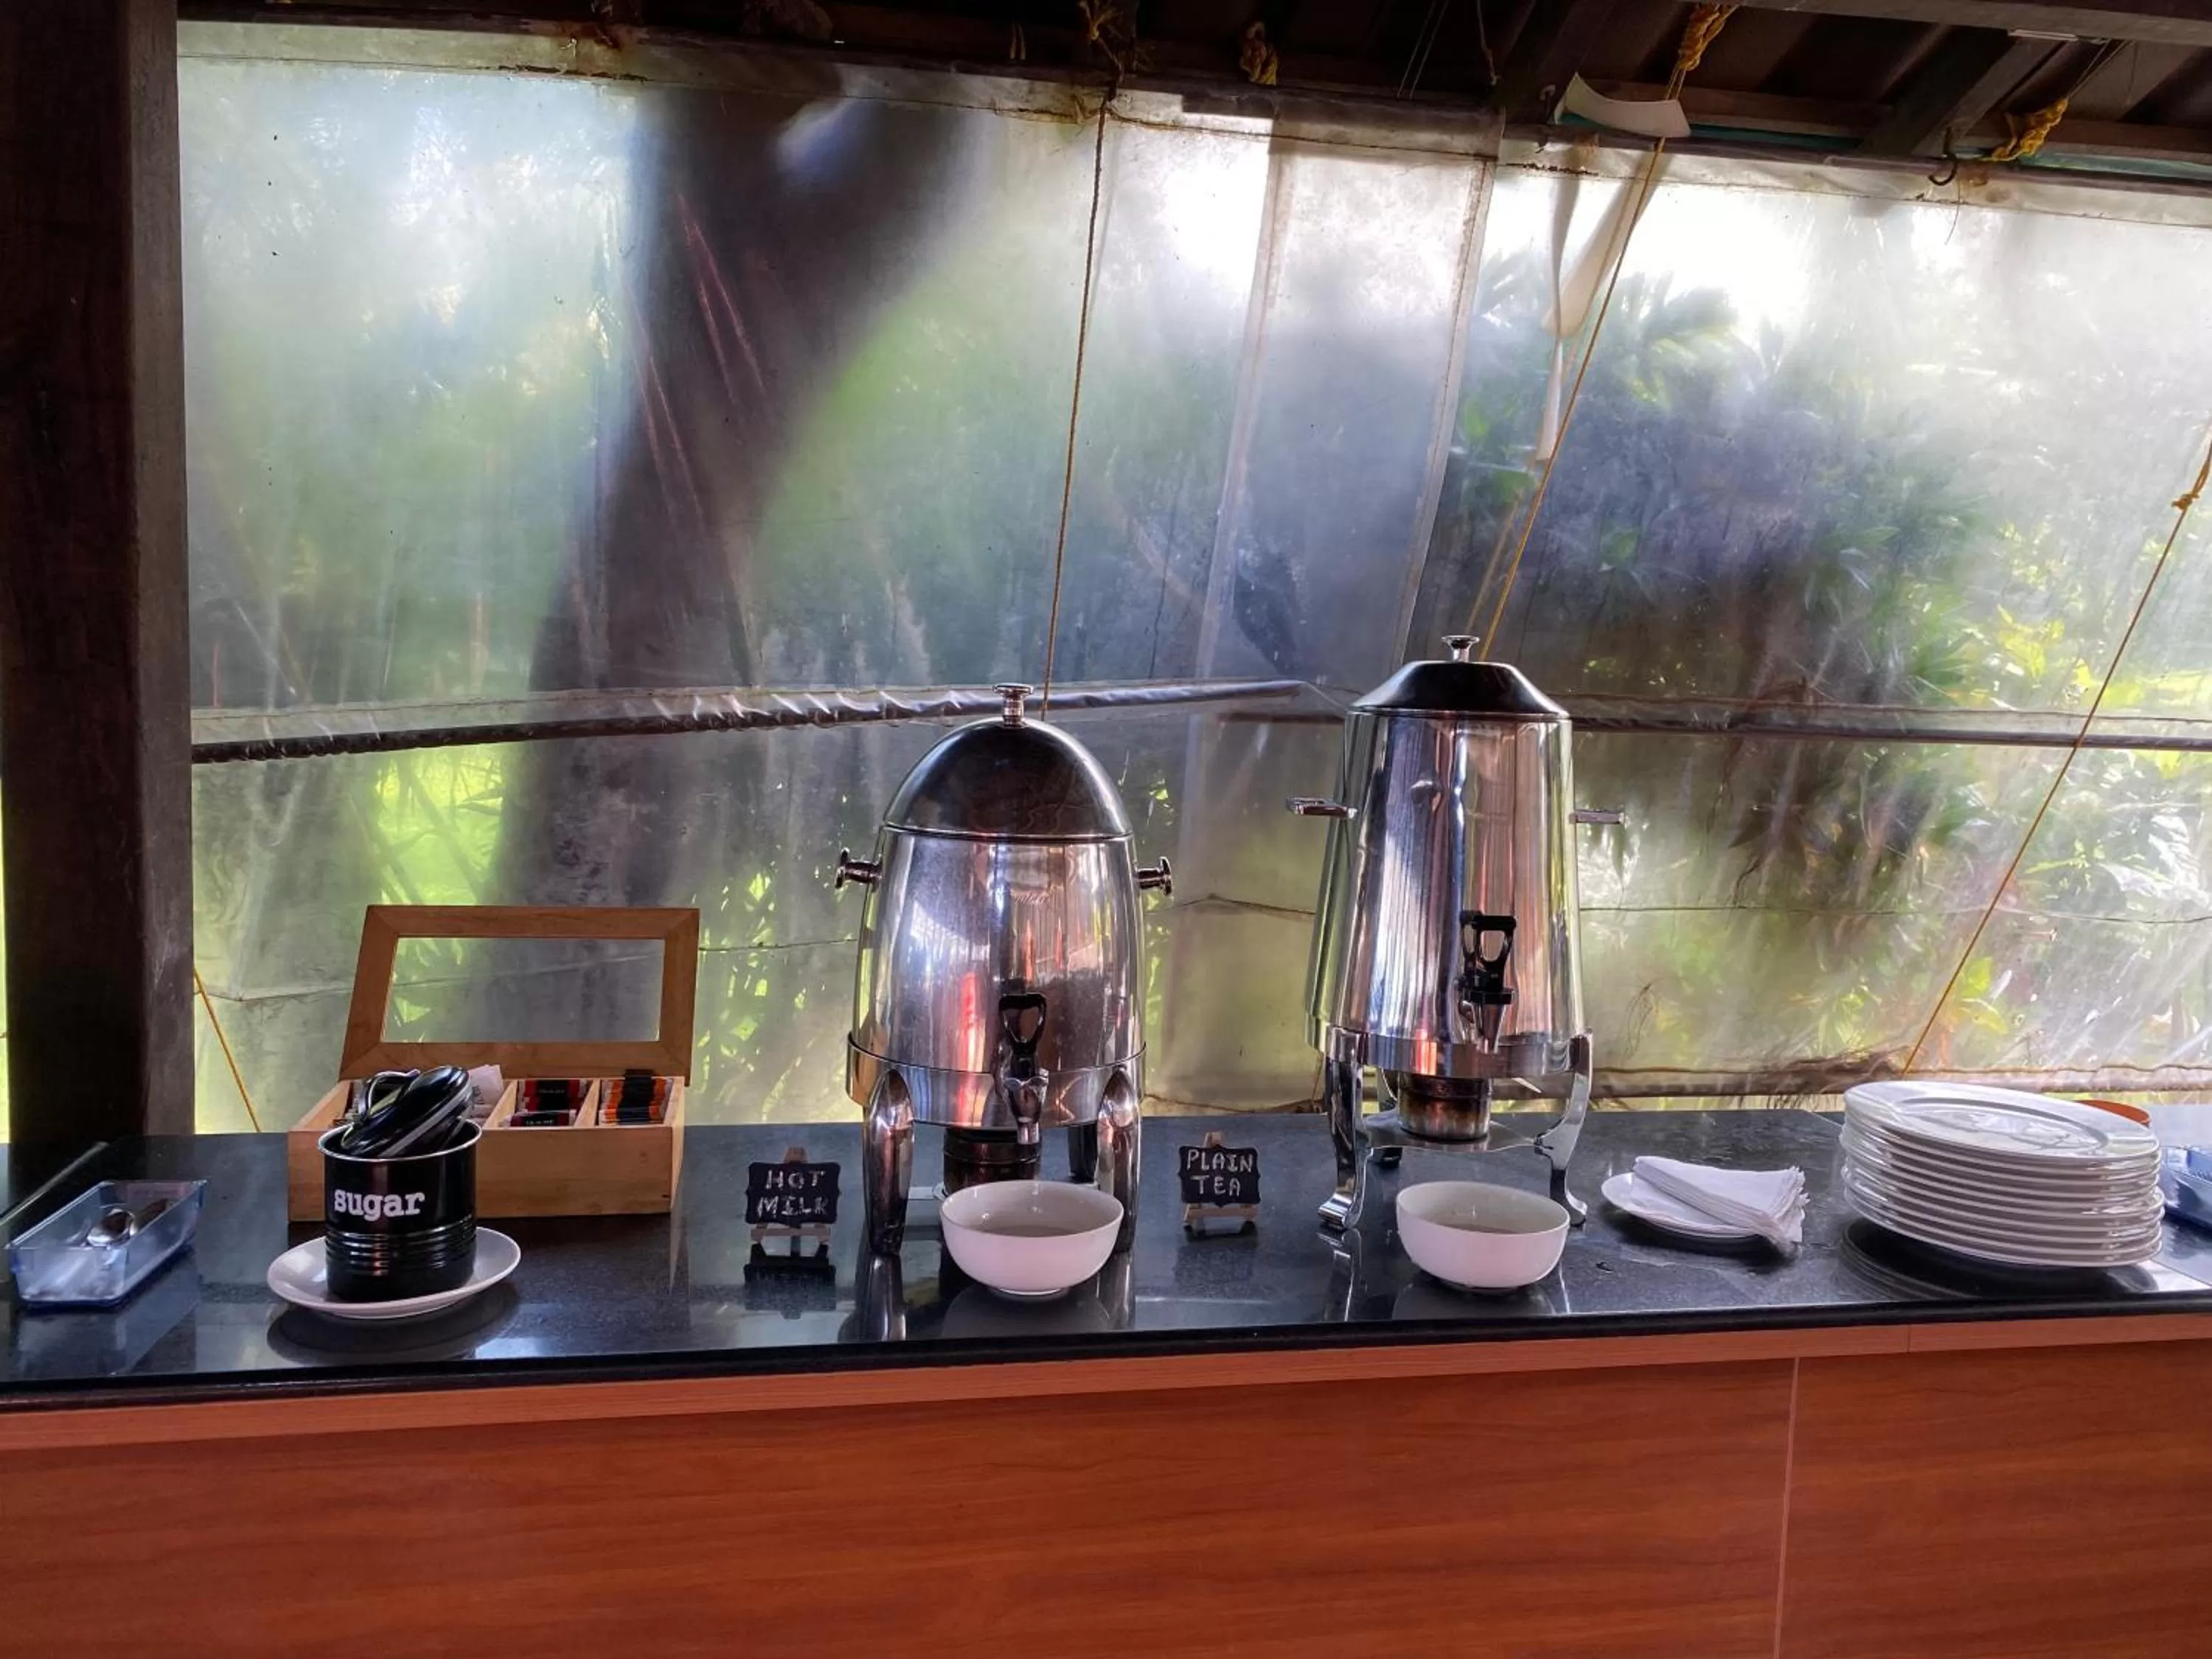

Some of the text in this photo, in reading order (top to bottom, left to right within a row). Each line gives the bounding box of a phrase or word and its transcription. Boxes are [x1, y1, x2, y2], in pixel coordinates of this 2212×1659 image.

[1186, 1149, 1253, 1172] PLAIN
[765, 1169, 826, 1189] HOT
[1190, 1175, 1240, 1196] TEA
[334, 1189, 425, 1222] sugar
